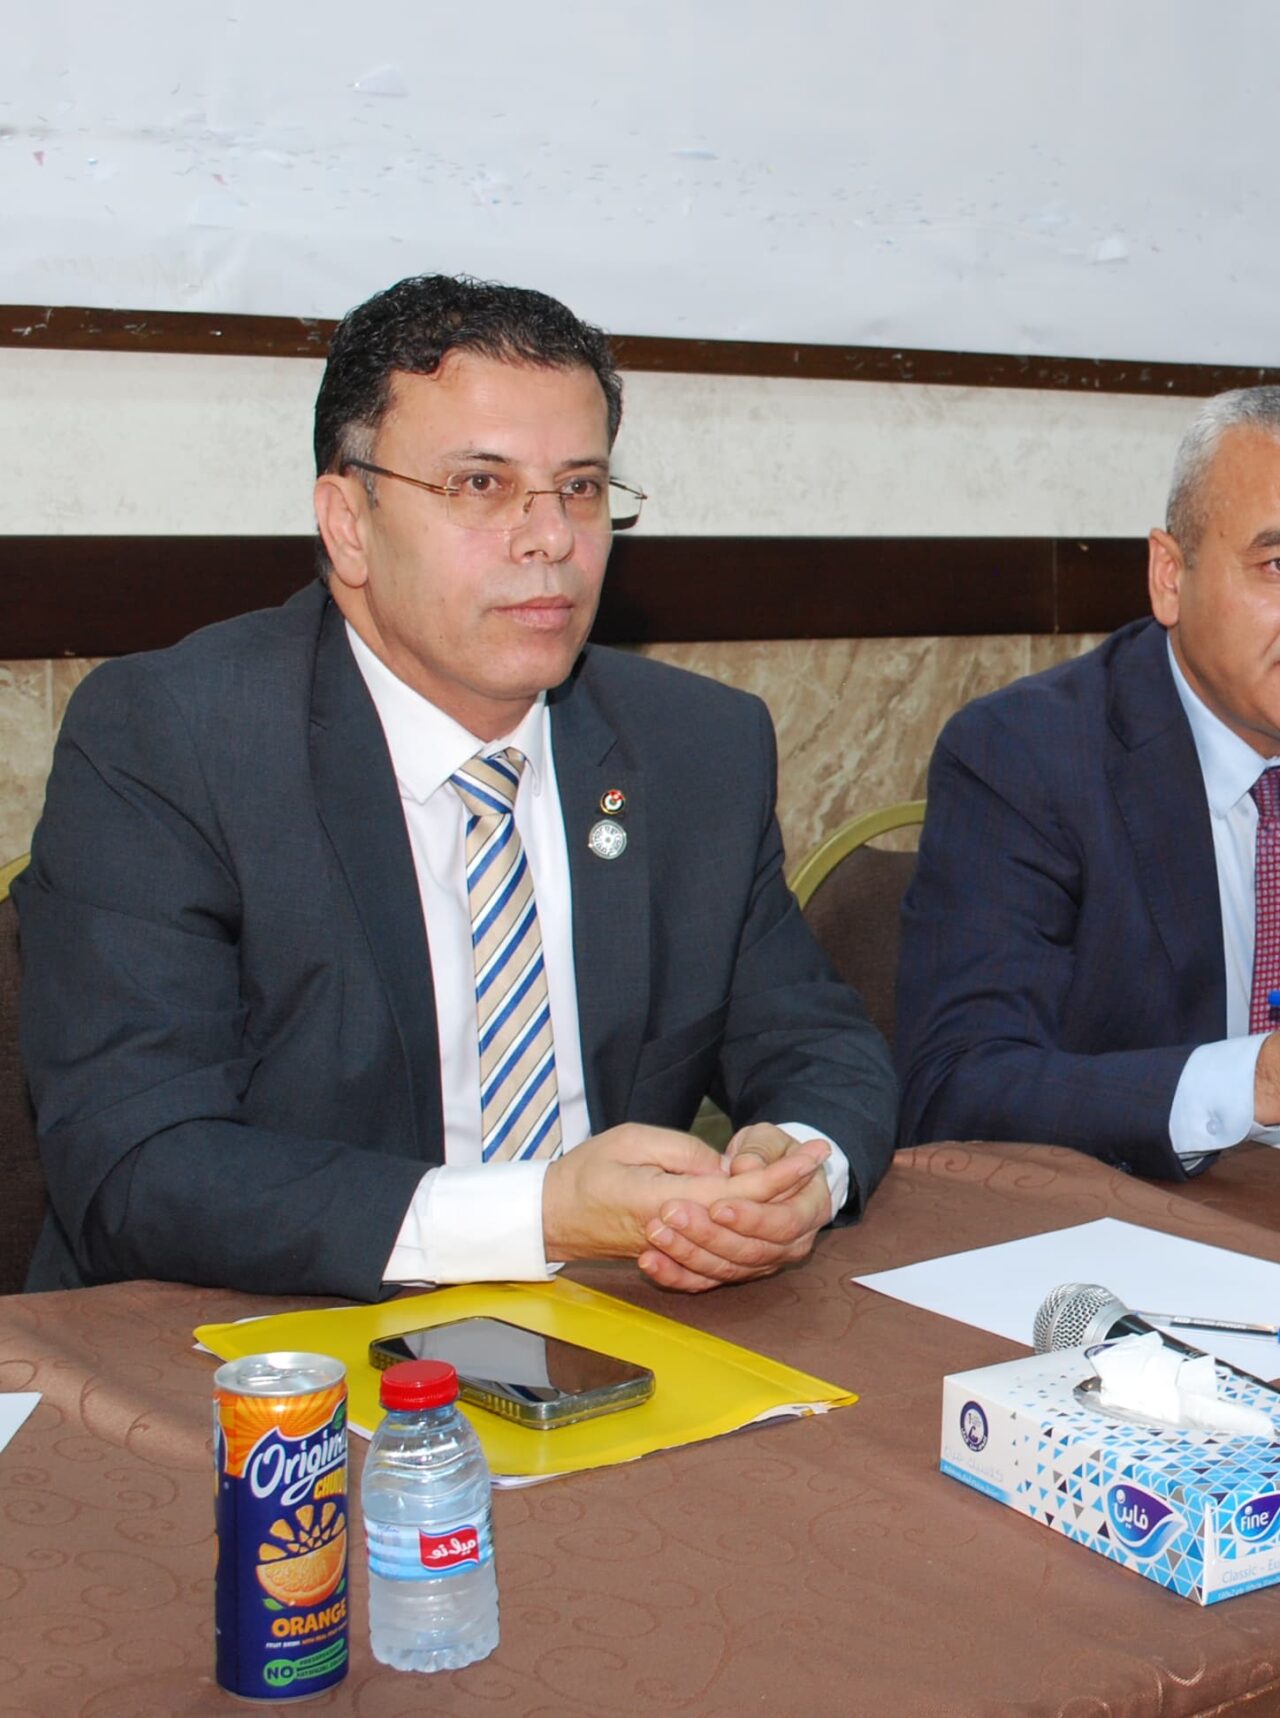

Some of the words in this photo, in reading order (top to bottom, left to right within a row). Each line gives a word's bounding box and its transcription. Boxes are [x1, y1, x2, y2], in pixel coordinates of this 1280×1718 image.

[1113, 1488, 1148, 1530] فاين
[1222, 1563, 1256, 1584] Classic
[272, 1597, 346, 1638] ORANGE
[266, 1666, 293, 1680] NO
